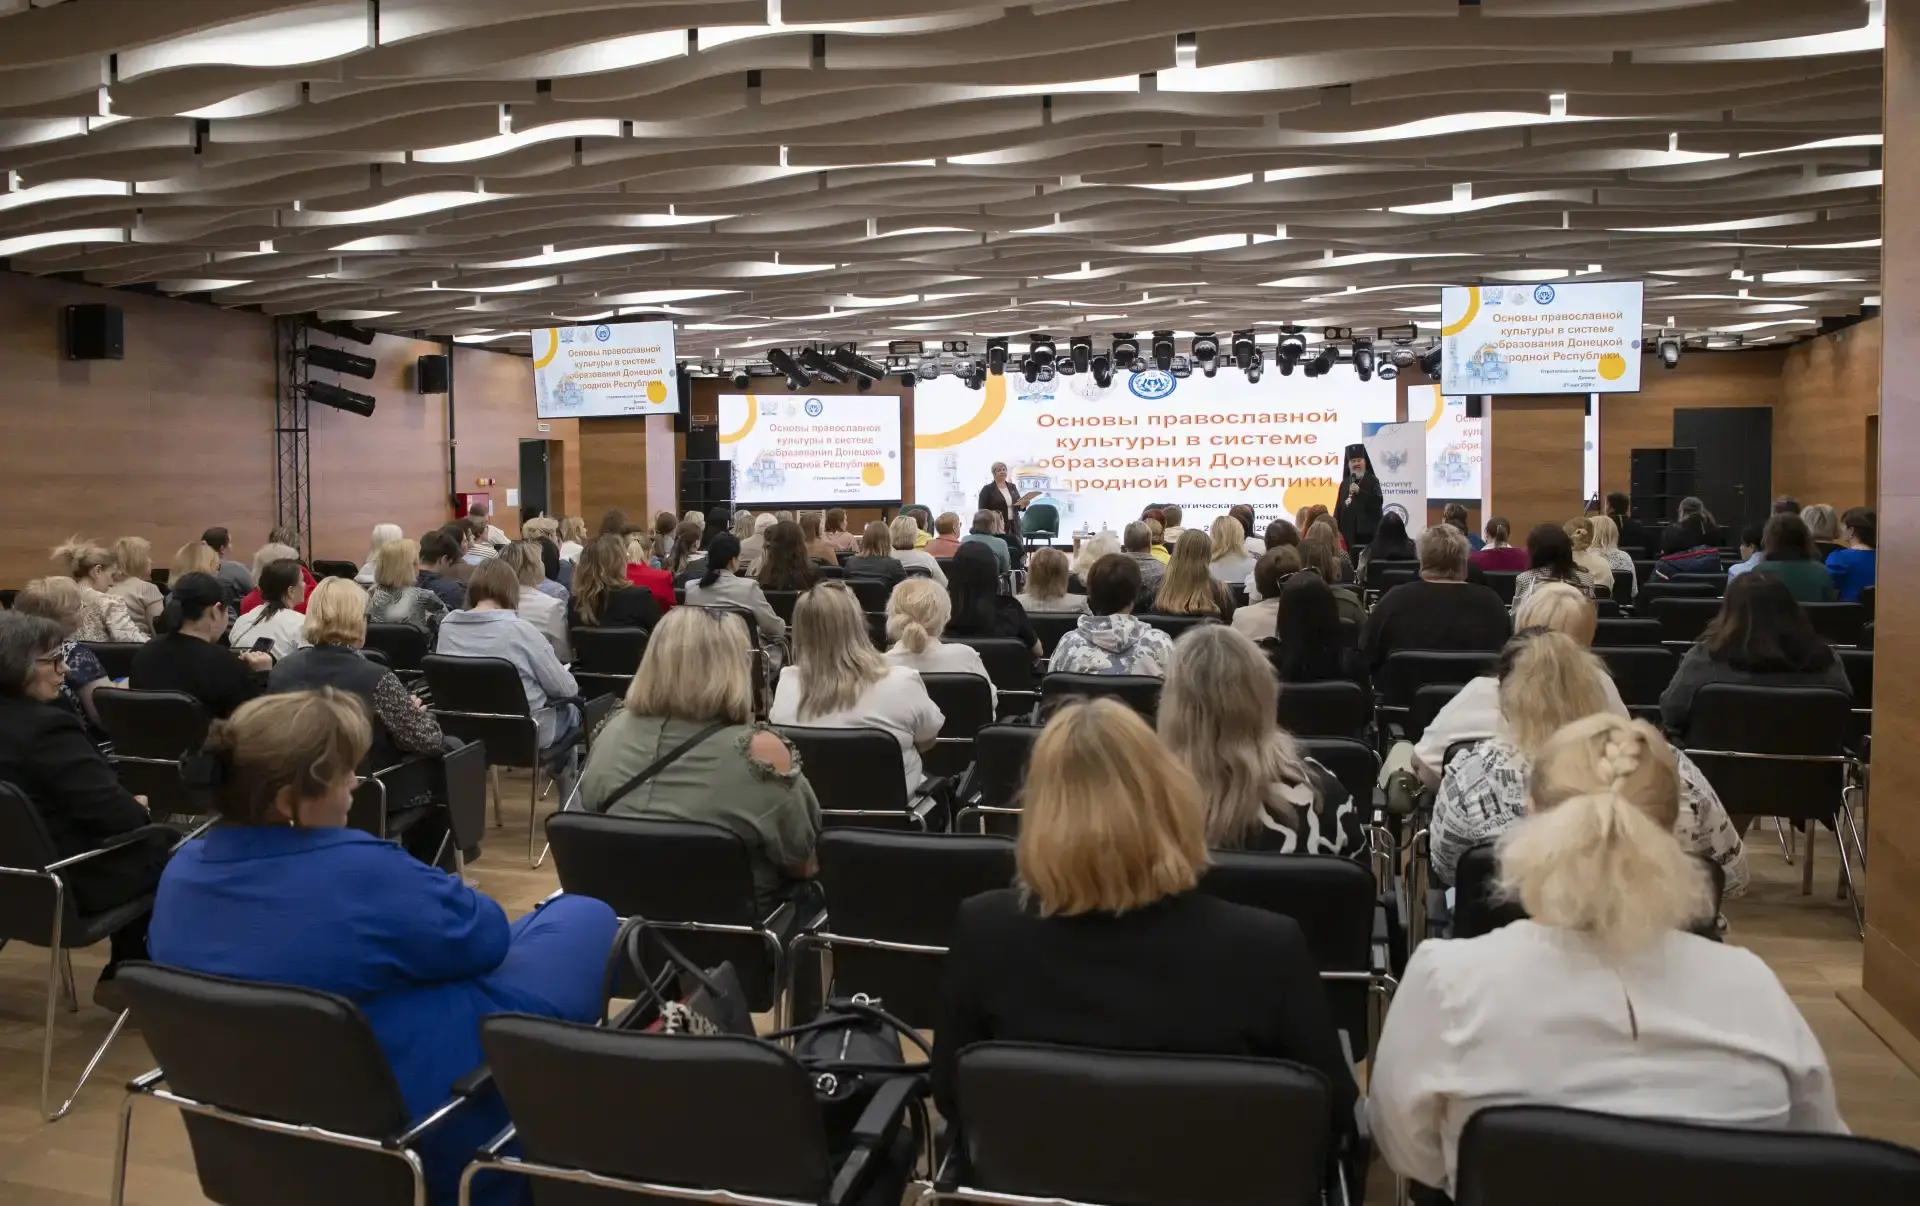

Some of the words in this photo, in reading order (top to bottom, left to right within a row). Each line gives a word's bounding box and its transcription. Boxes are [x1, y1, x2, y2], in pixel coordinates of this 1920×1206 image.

[1492, 313, 1538, 323] Основы
[1541, 310, 1623, 323] православной
[1501, 327, 1554, 337] культуры
[1568, 325, 1614, 334] системе
[1493, 339, 1564, 350] образования
[1567, 337, 1623, 349] Донецкой
[568, 349, 600, 357] Основы
[602, 345, 661, 357] православной
[1553, 351, 1620, 362] Республики
[574, 360, 613, 369] культуры
[622, 358, 656, 366] системе
[569, 370, 621, 380] образования
[623, 368, 663, 377] Донецкой
[613, 379, 662, 389] Республики
[1037, 414, 1138, 428] Основы
[1147, 408, 1338, 428] православной
[769, 423, 809, 432] Основы
[777, 436, 823, 446] культуры
[834, 436, 874, 444] системе
[1056, 435, 1177, 451] культуры
[1185, 435, 1201, 446] в
[1209, 433, 1318, 446] системе
[769, 448, 833, 457] образования
[835, 447, 882, 457] Донецкой
[823, 459, 879, 469] Республики
[1037, 455, 1201, 471] образования
[1209, 451, 1339, 469] Донецкой
[1177, 473, 1333, 491] Республики
